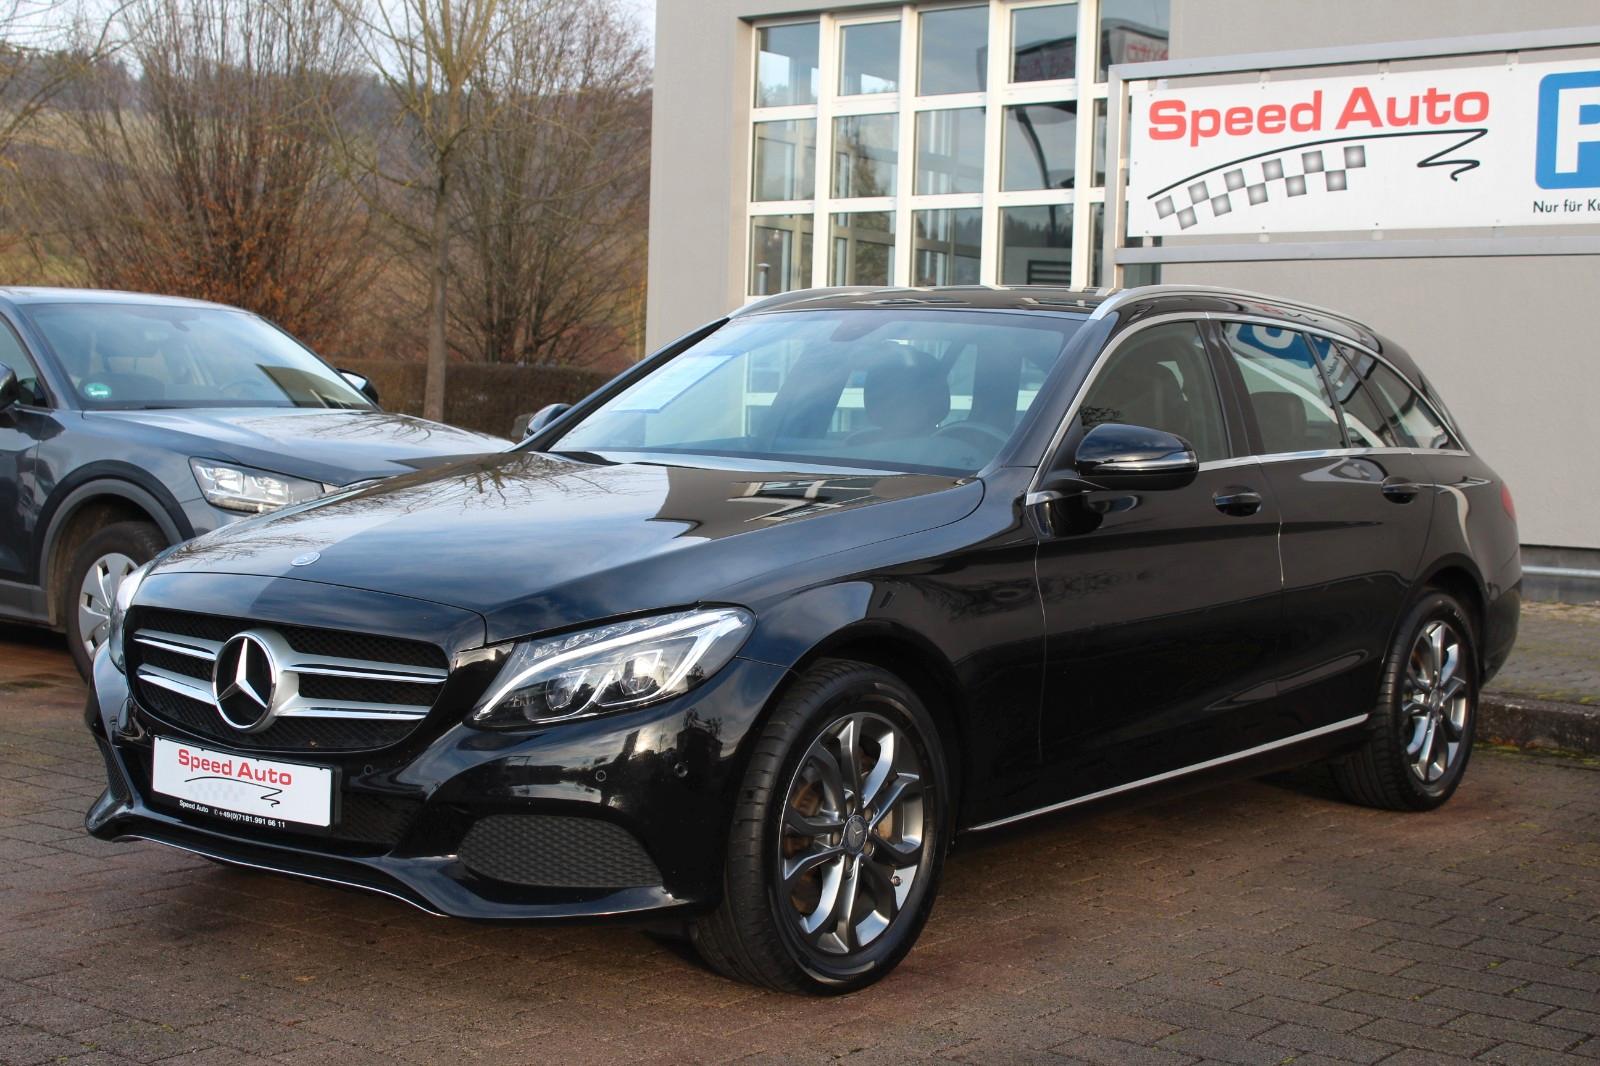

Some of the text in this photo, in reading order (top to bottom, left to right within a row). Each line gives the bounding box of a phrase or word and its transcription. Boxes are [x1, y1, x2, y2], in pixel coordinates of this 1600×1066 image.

[1148, 87, 1490, 147] Speed Auto
[1533, 201, 1559, 213] Nur
[1563, 199, 1582, 212] für
[178, 748, 292, 786] Speed Auto
[179, 800, 196, 809] Speed
[196, 804, 209, 813] Auto
[277, 820, 285, 828] 11
